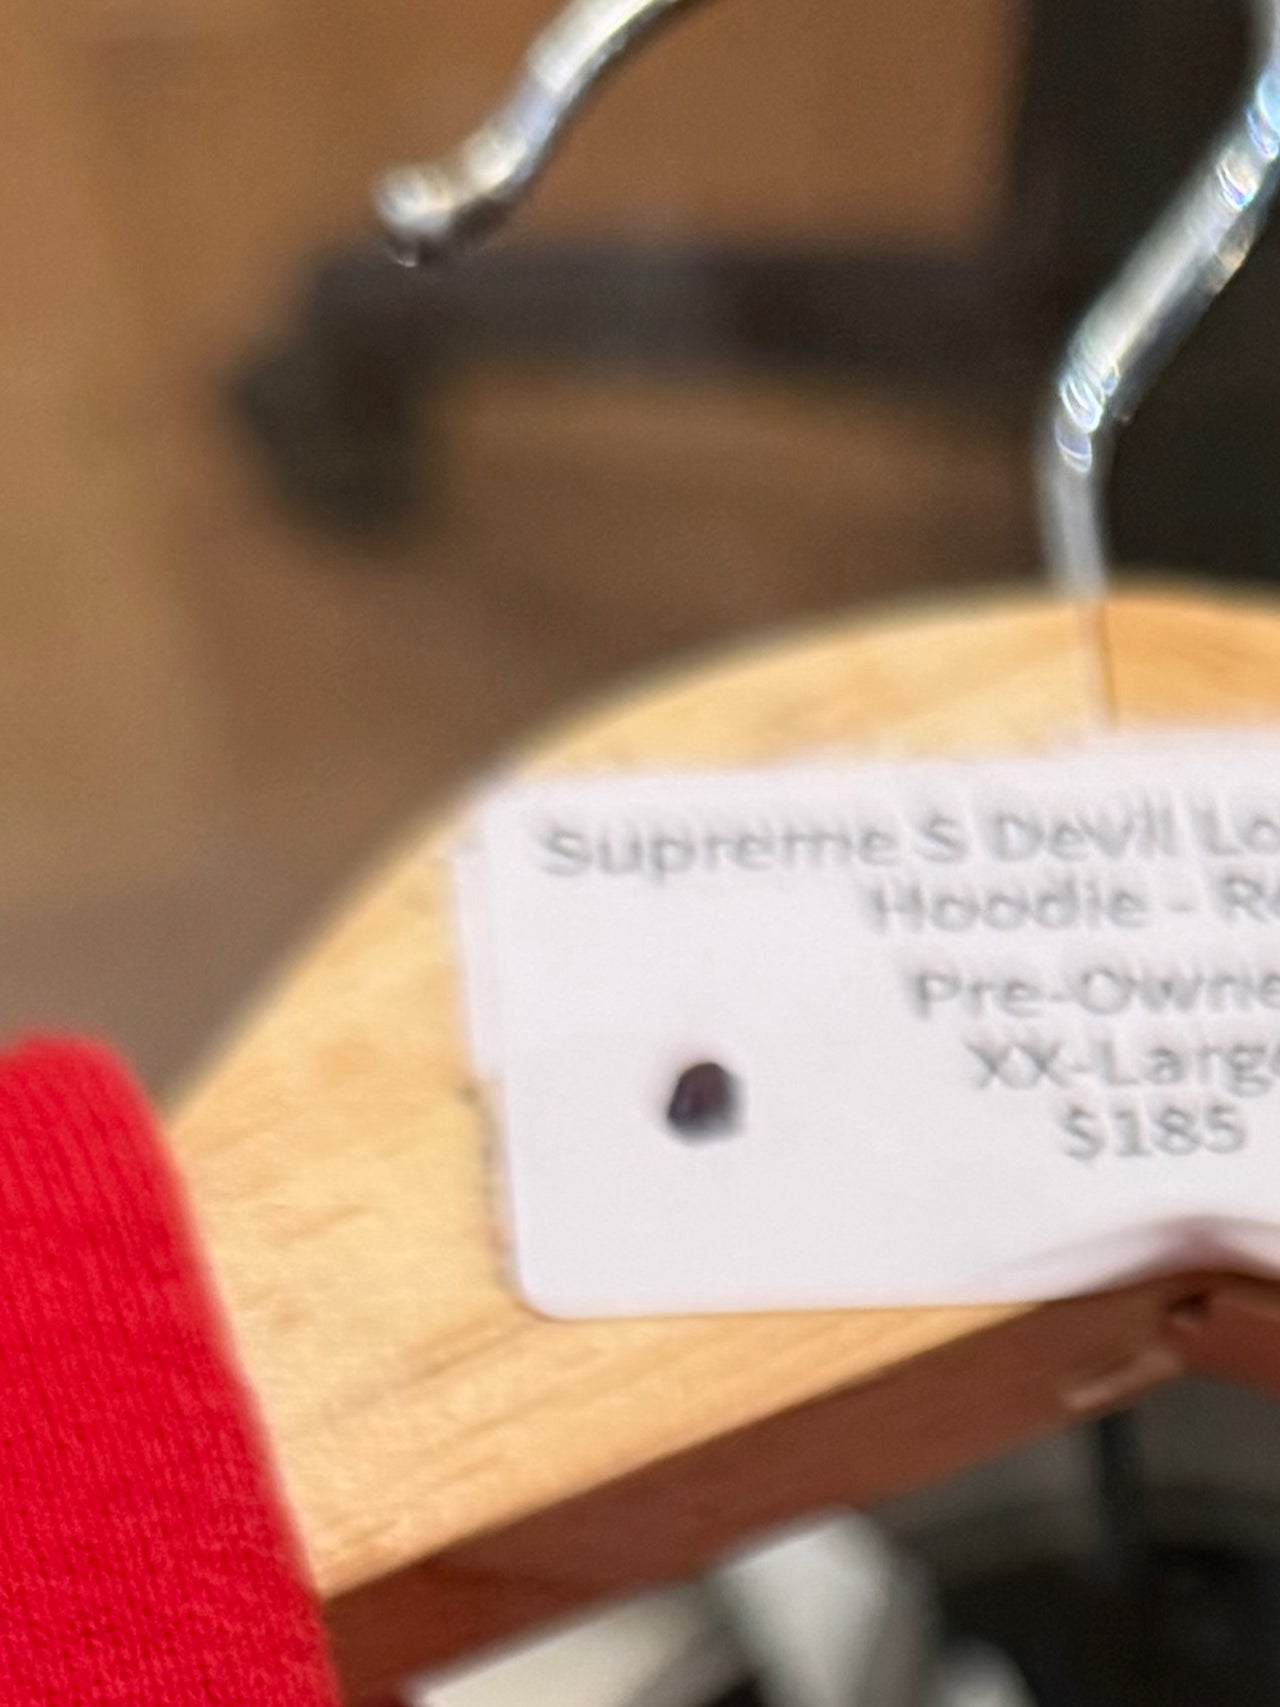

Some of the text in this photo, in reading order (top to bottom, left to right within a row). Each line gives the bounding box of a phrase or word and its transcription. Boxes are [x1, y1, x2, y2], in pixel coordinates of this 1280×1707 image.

[540, 818, 900, 888] Supreme
[919, 812, 970, 865] S
[994, 797, 1178, 864] Devil
[868, 872, 1146, 932] Hoodie
[1060, 1100, 1247, 1160] $185
